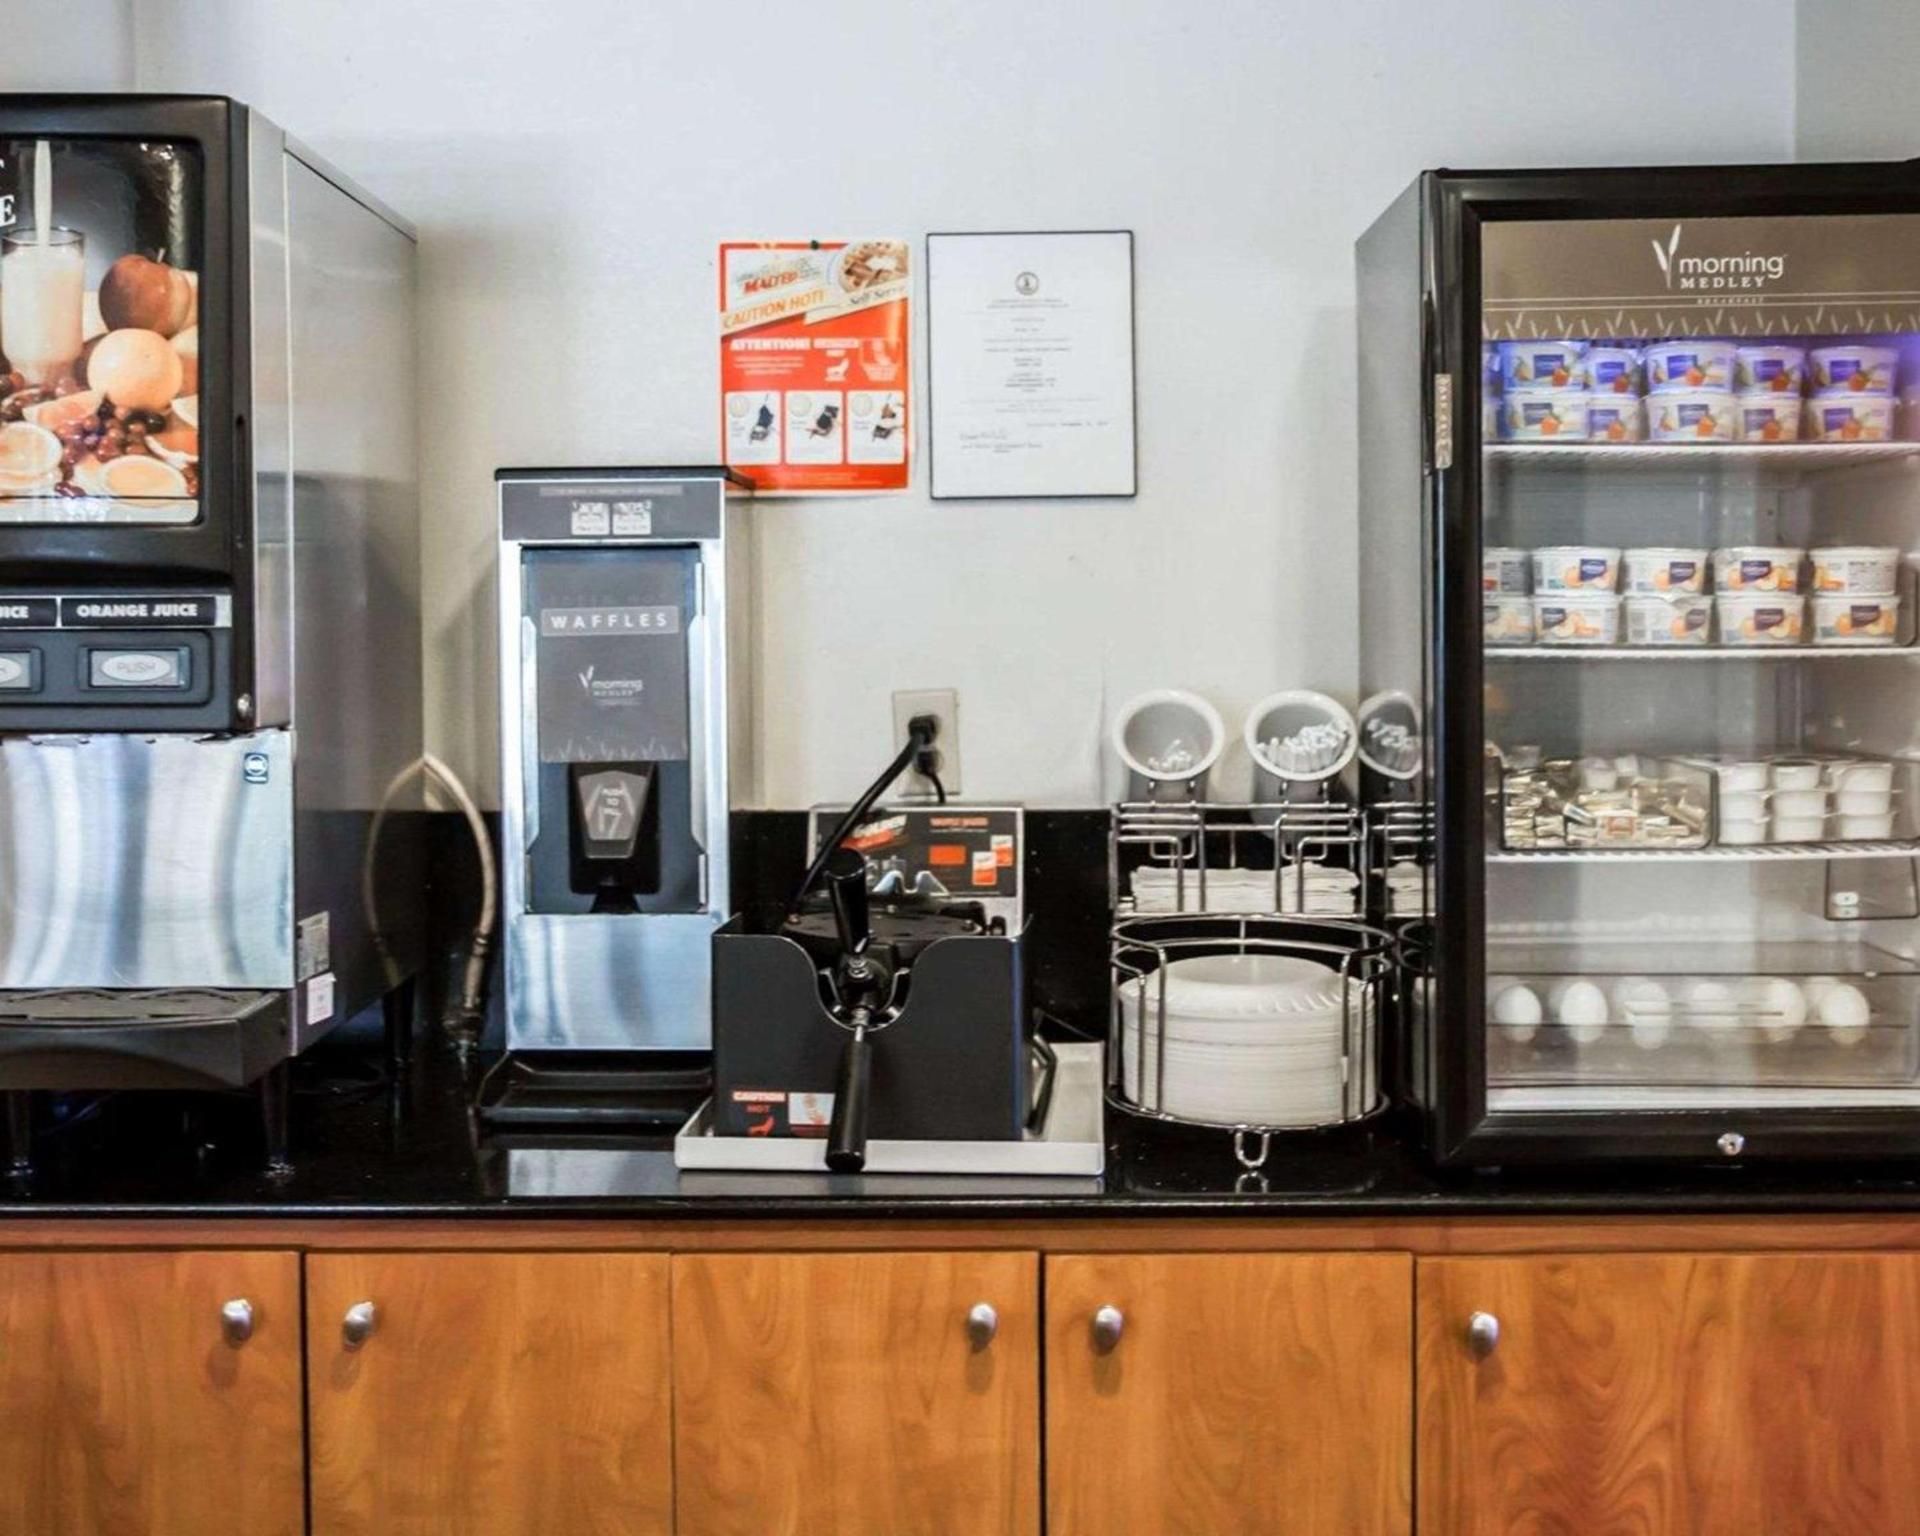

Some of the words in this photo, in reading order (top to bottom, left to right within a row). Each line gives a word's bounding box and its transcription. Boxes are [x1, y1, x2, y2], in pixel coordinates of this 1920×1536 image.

[1680, 251, 1783, 279] morning
[1681, 276, 1765, 289] MEDLEY
[723, 301, 785, 329] CAUTION
[76, 603, 148, 617] ORANGE
[152, 603, 198, 617] JUICE
[550, 612, 668, 629] WAFFLES
